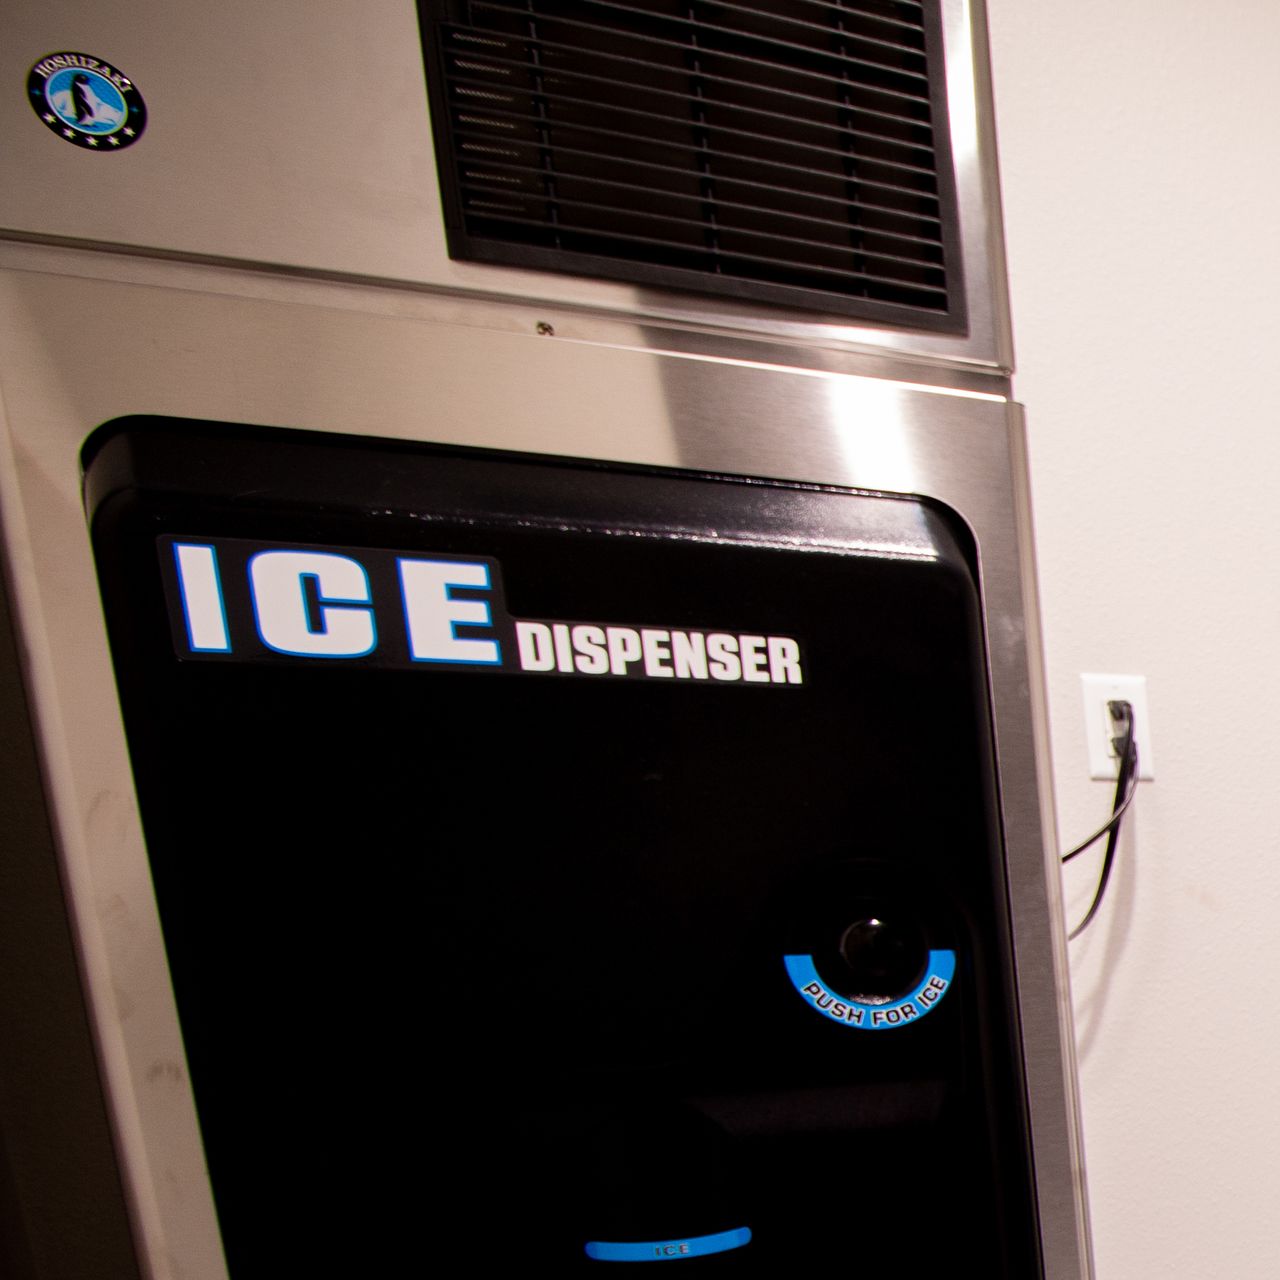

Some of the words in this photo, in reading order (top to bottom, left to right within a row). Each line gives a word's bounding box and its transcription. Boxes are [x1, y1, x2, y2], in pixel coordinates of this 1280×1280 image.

[34, 54, 133, 93] HOSHIZAKI
[173, 541, 502, 665] ICE
[515, 621, 803, 684] DISPENSER
[803, 981, 864, 1024] PUSH
[872, 1003, 917, 1026] FOR
[916, 974, 948, 1008] ICE
[655, 1243, 689, 1256] ICE
